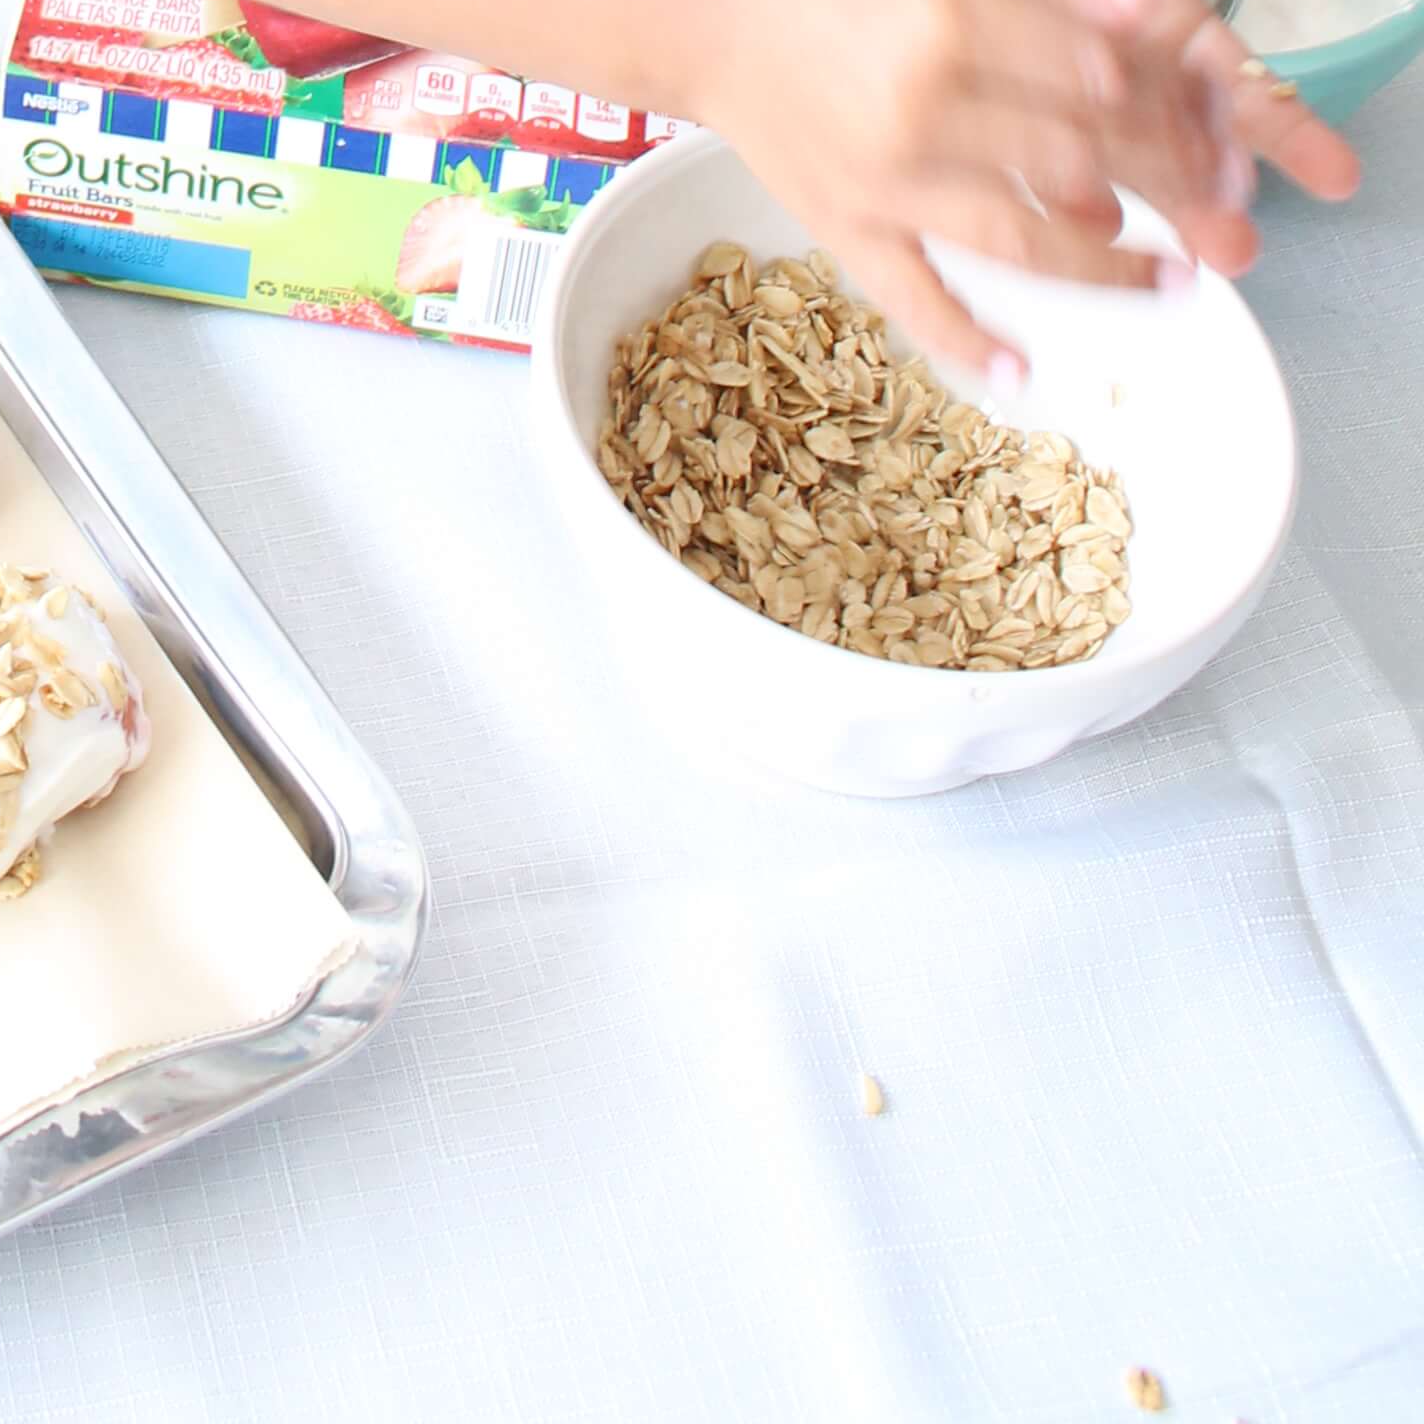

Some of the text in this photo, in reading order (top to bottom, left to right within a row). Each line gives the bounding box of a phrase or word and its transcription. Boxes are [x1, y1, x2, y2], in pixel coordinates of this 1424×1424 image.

[45, 0, 202, 35] PALETAS DE FRUTA
[77, 42, 99, 64] FL
[200, 61, 243, 88] (435
[247, 69, 287, 98] mL)
[427, 71, 455, 92] 60
[374, 80, 402, 95] PER
[372, 93, 401, 110] BAR
[23, 137, 285, 212] Outshine
[28, 177, 134, 208] Fruit Bars
[28, 196, 120, 223] strawberry
[283, 283, 359, 302] PLEASE RECYCLE
